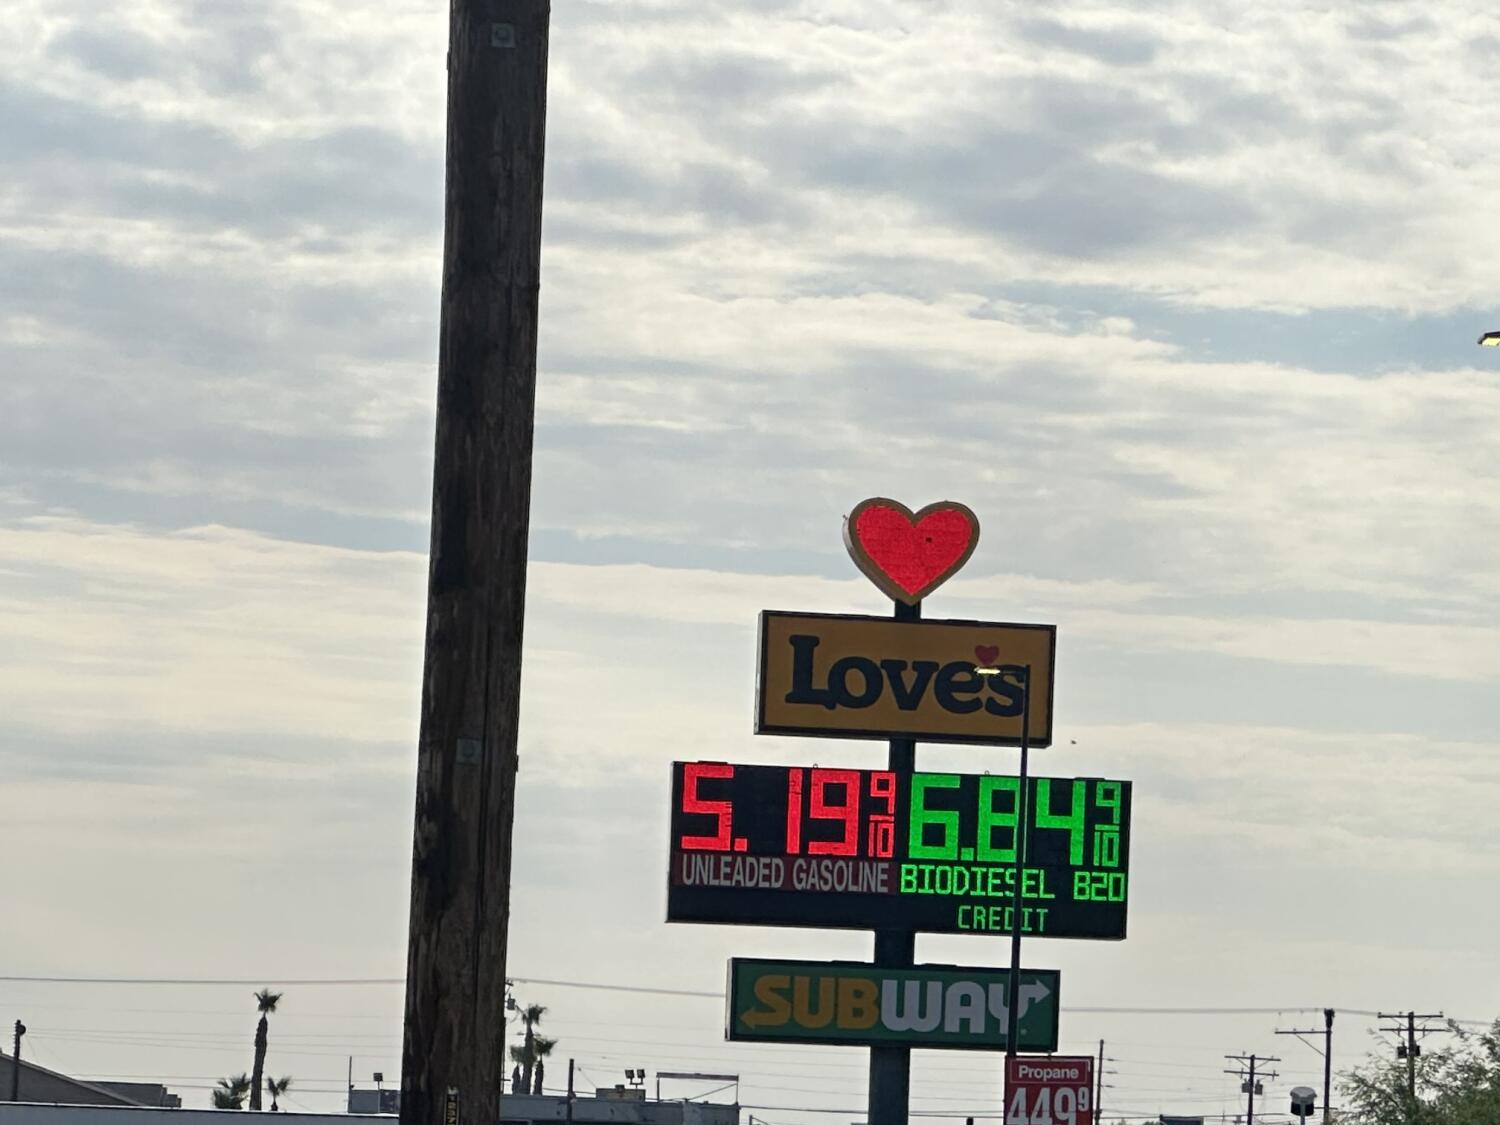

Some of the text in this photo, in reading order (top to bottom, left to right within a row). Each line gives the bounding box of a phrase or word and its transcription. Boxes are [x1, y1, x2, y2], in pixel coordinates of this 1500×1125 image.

[682, 763, 860, 856] 5.19
[682, 854, 889, 893] UNLEADED GASOLINE
[901, 864, 1126, 902] BIODIESEL B20
[958, 905, 1048, 932] CREDIT
[741, 975, 1050, 1035] SUBWAY
[1018, 1065, 1079, 1082] Propane
